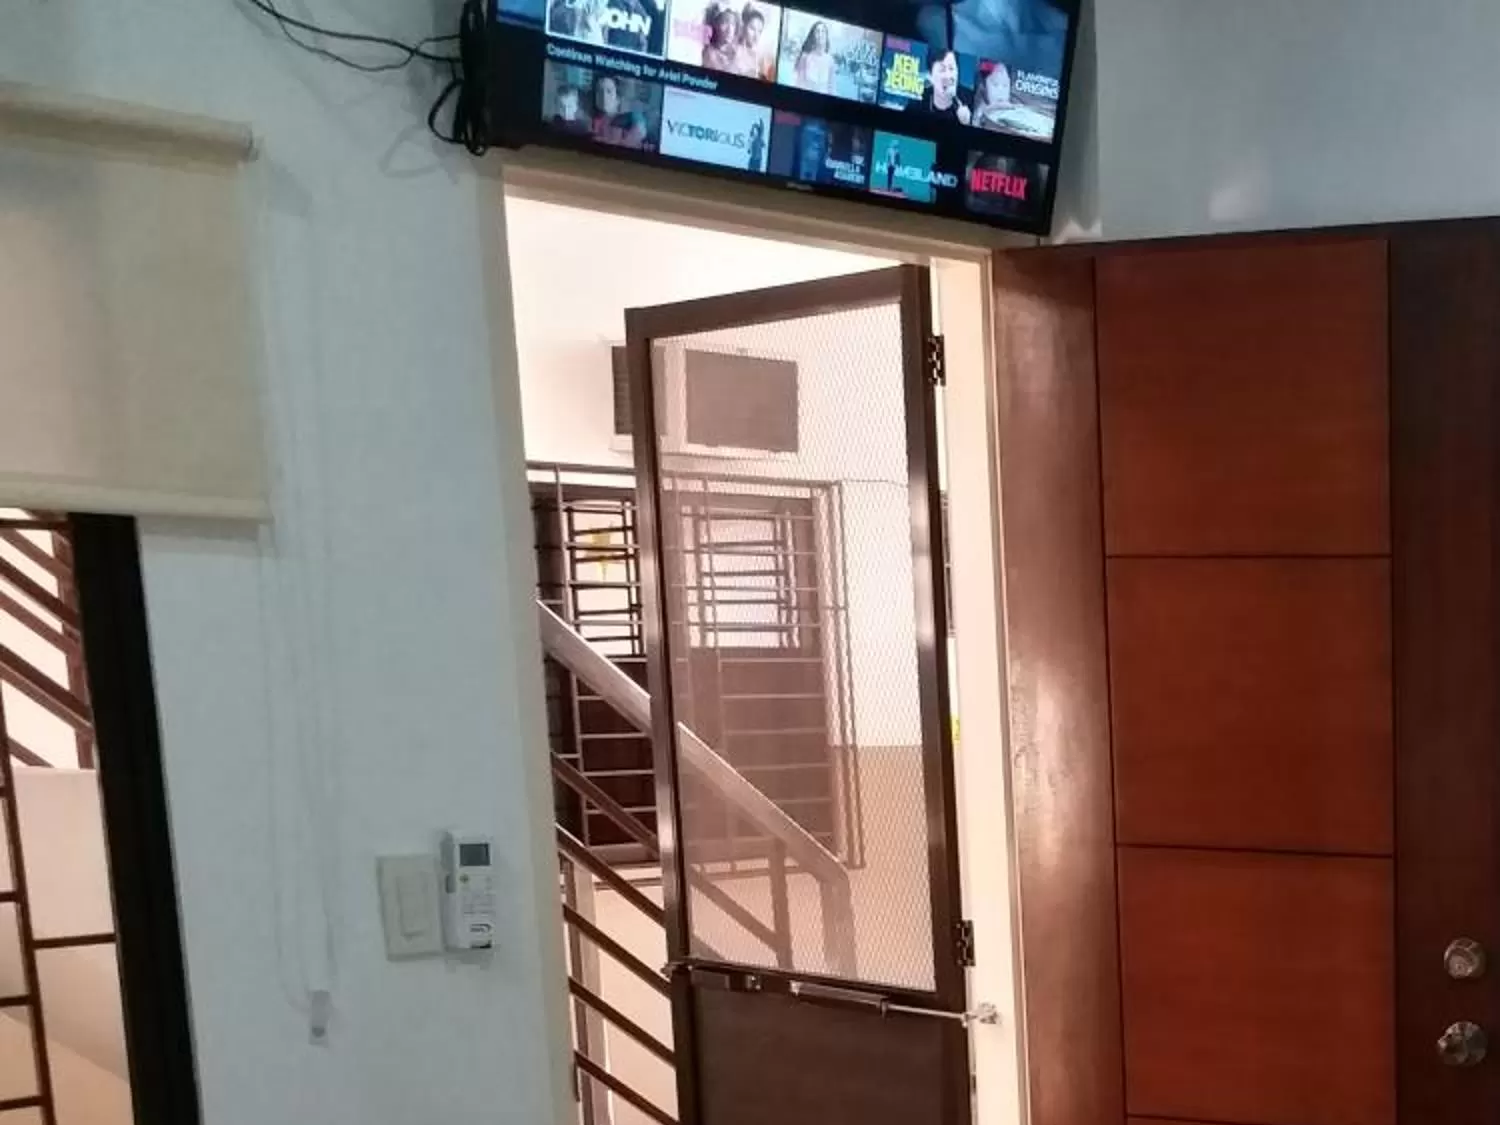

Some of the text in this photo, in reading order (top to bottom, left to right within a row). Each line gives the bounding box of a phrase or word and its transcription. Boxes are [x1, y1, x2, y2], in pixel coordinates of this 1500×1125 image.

[893, 52, 920, 76] KEN
[667, 119, 745, 149] VICTORIOUS
[970, 168, 1028, 200] NETFLIX
